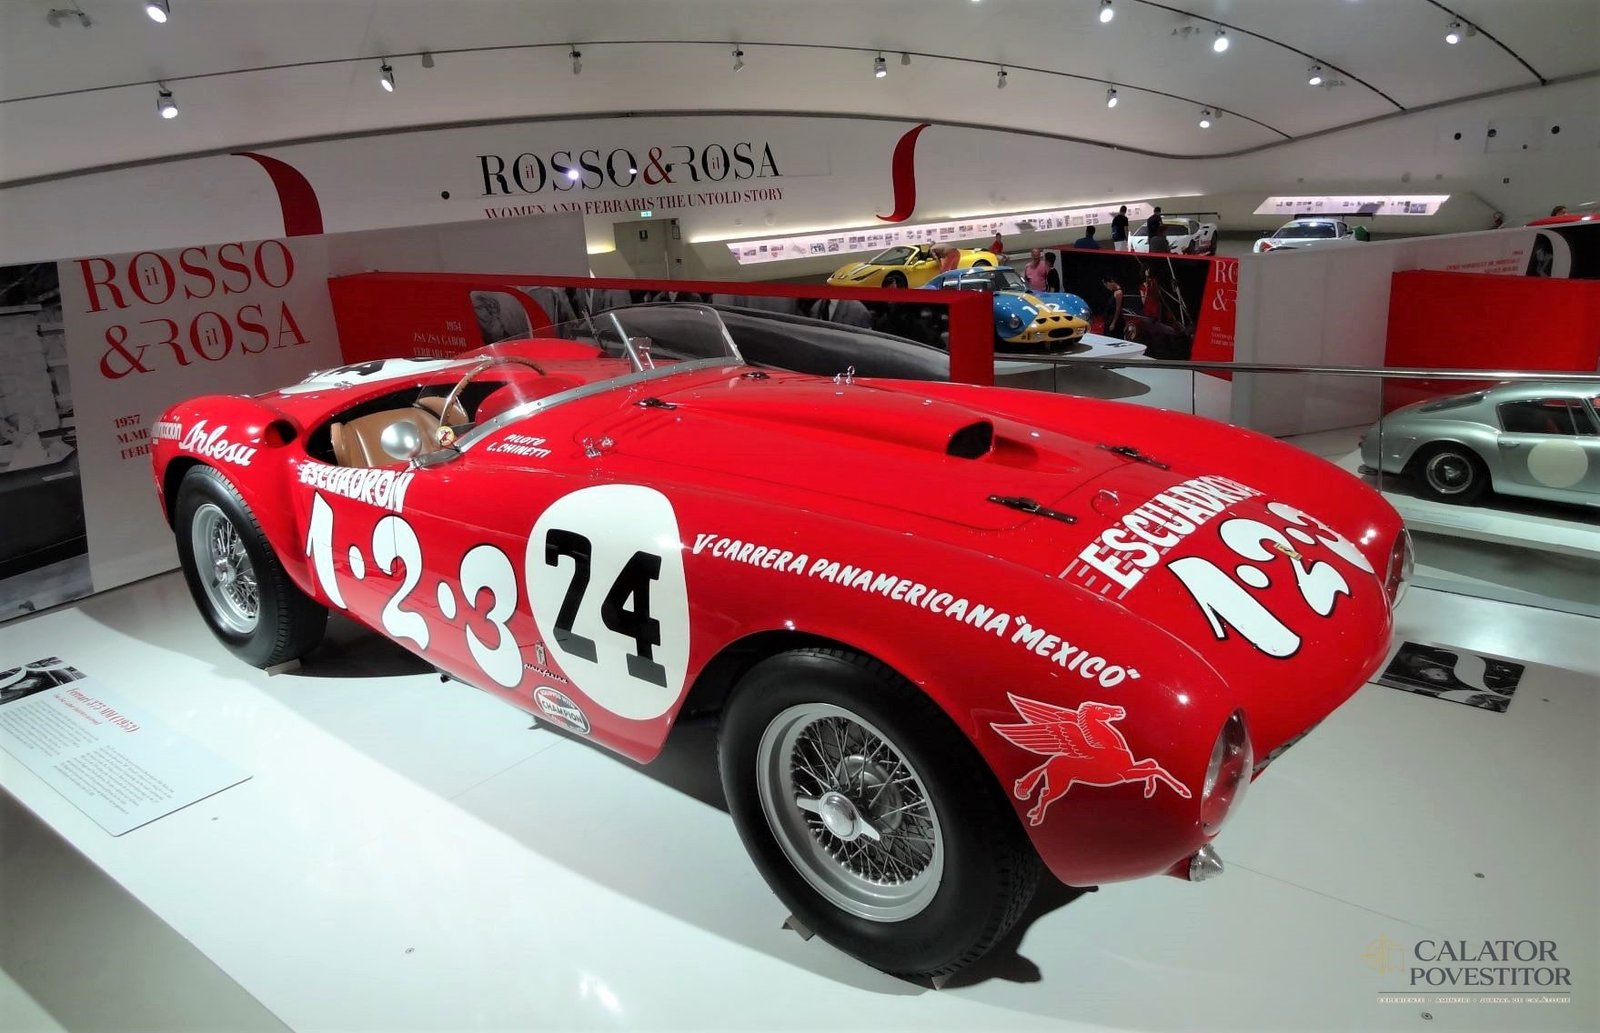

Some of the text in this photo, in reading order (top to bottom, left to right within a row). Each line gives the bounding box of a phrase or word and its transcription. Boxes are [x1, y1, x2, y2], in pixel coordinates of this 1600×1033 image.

[585, 199, 655, 215] FERRARIS
[656, 194, 686, 210] THE
[686, 191, 742, 207] UNTOLD
[743, 187, 785, 203] STORY
[73, 239, 294, 313] ROSSO
[115, 414, 141, 429] 1957
[503, 433, 547, 446] PILOTO
[545, 528, 668, 689] 24
[809, 558, 1011, 637] PANAMERICANA
[541, 700, 583, 723] CHAMPION
